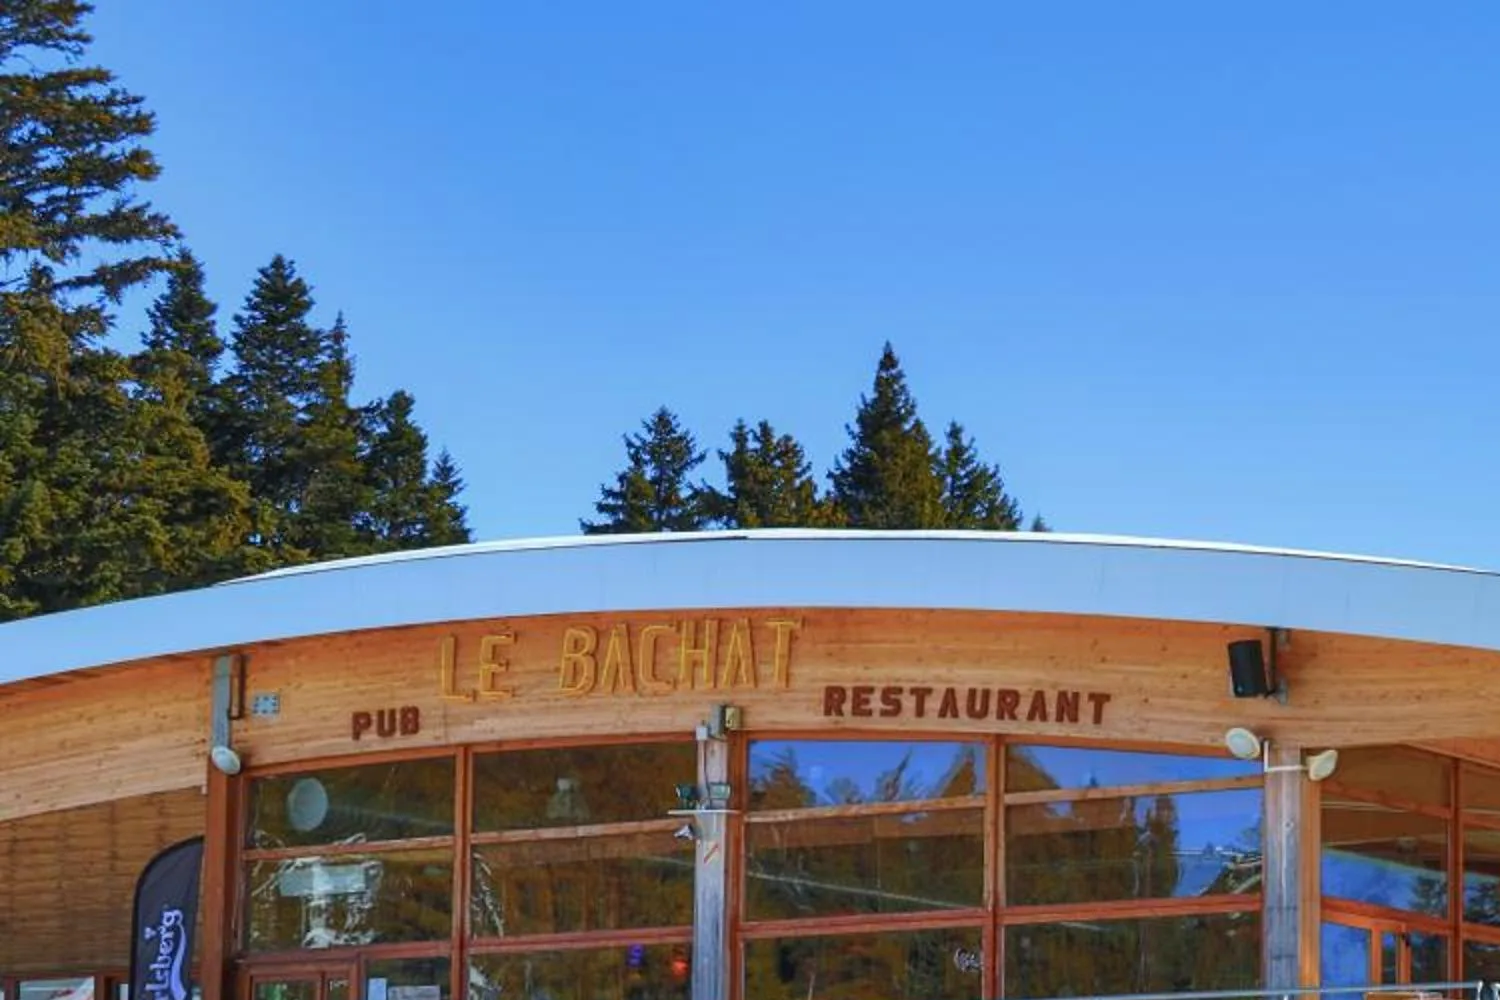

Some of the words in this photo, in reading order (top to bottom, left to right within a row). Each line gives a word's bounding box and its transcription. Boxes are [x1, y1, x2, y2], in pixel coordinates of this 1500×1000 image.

[441, 631, 517, 702] LE
[559, 617, 804, 697] BACHAT
[352, 706, 420, 741] PUB
[823, 685, 1111, 724] RESTAURANT
